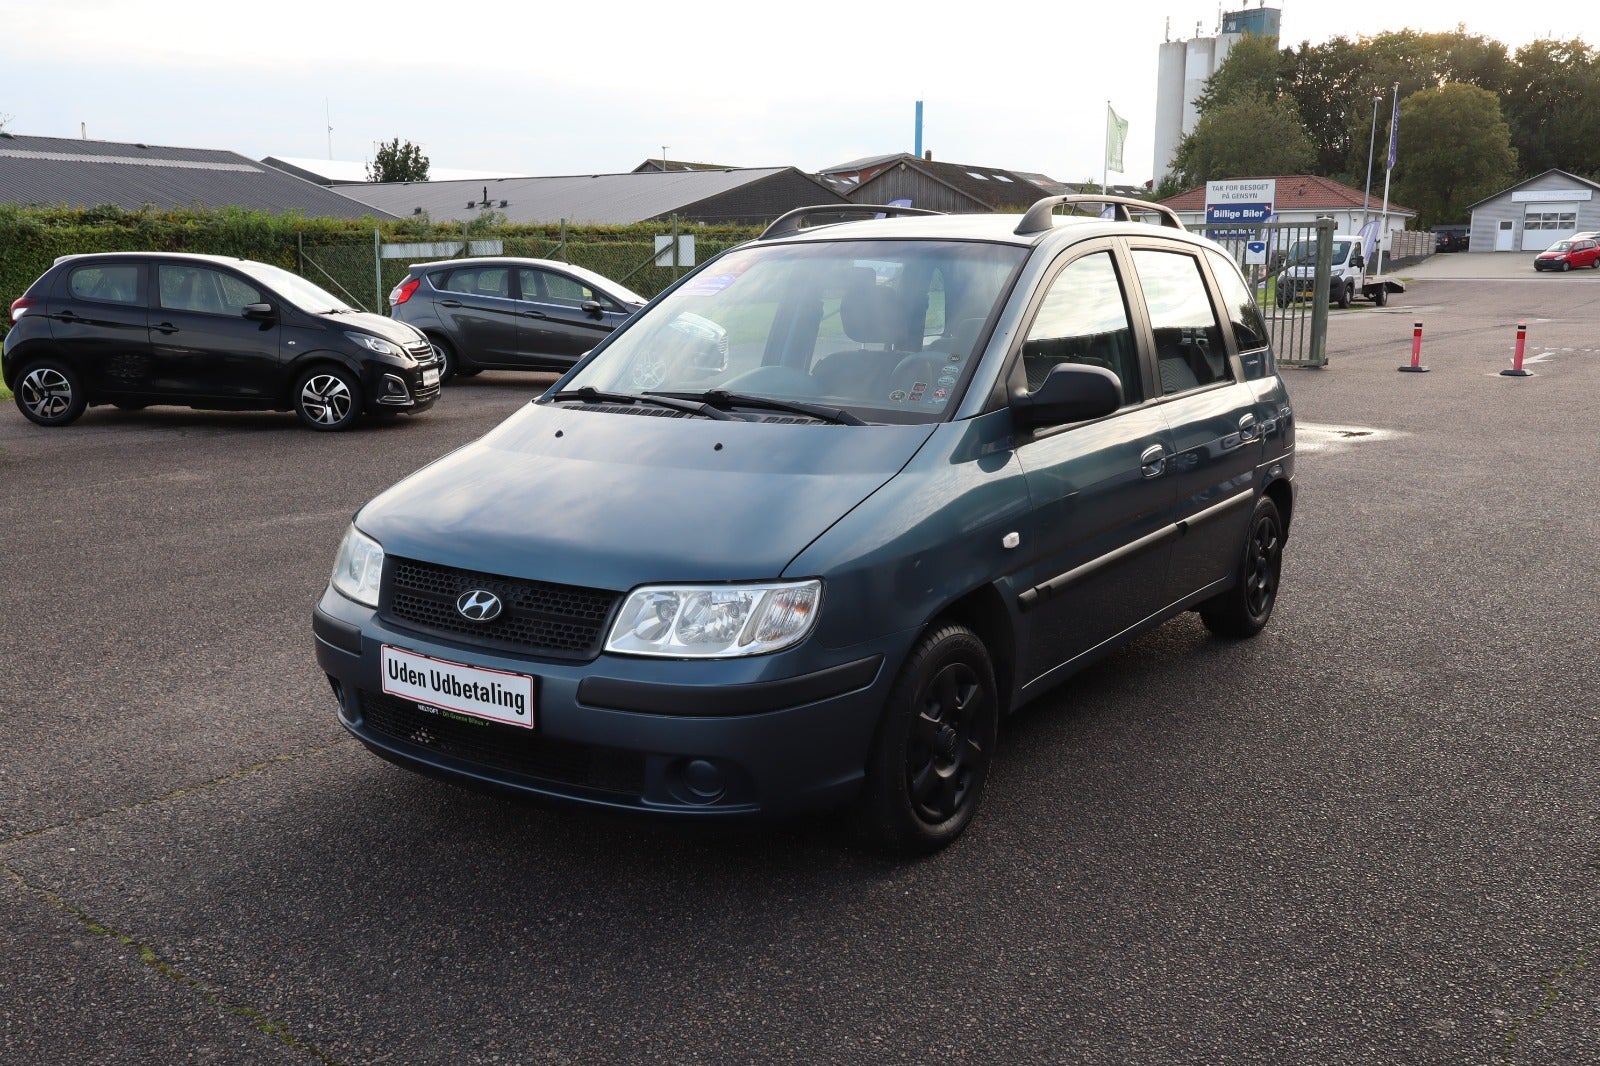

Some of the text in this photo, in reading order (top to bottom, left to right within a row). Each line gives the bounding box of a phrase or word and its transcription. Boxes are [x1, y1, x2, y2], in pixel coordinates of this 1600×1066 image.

[1240, 183, 1270, 191] BESØGET
[1213, 209, 1265, 219] Billige Biler
[388, 658, 525, 716] Uden Udbetaling
